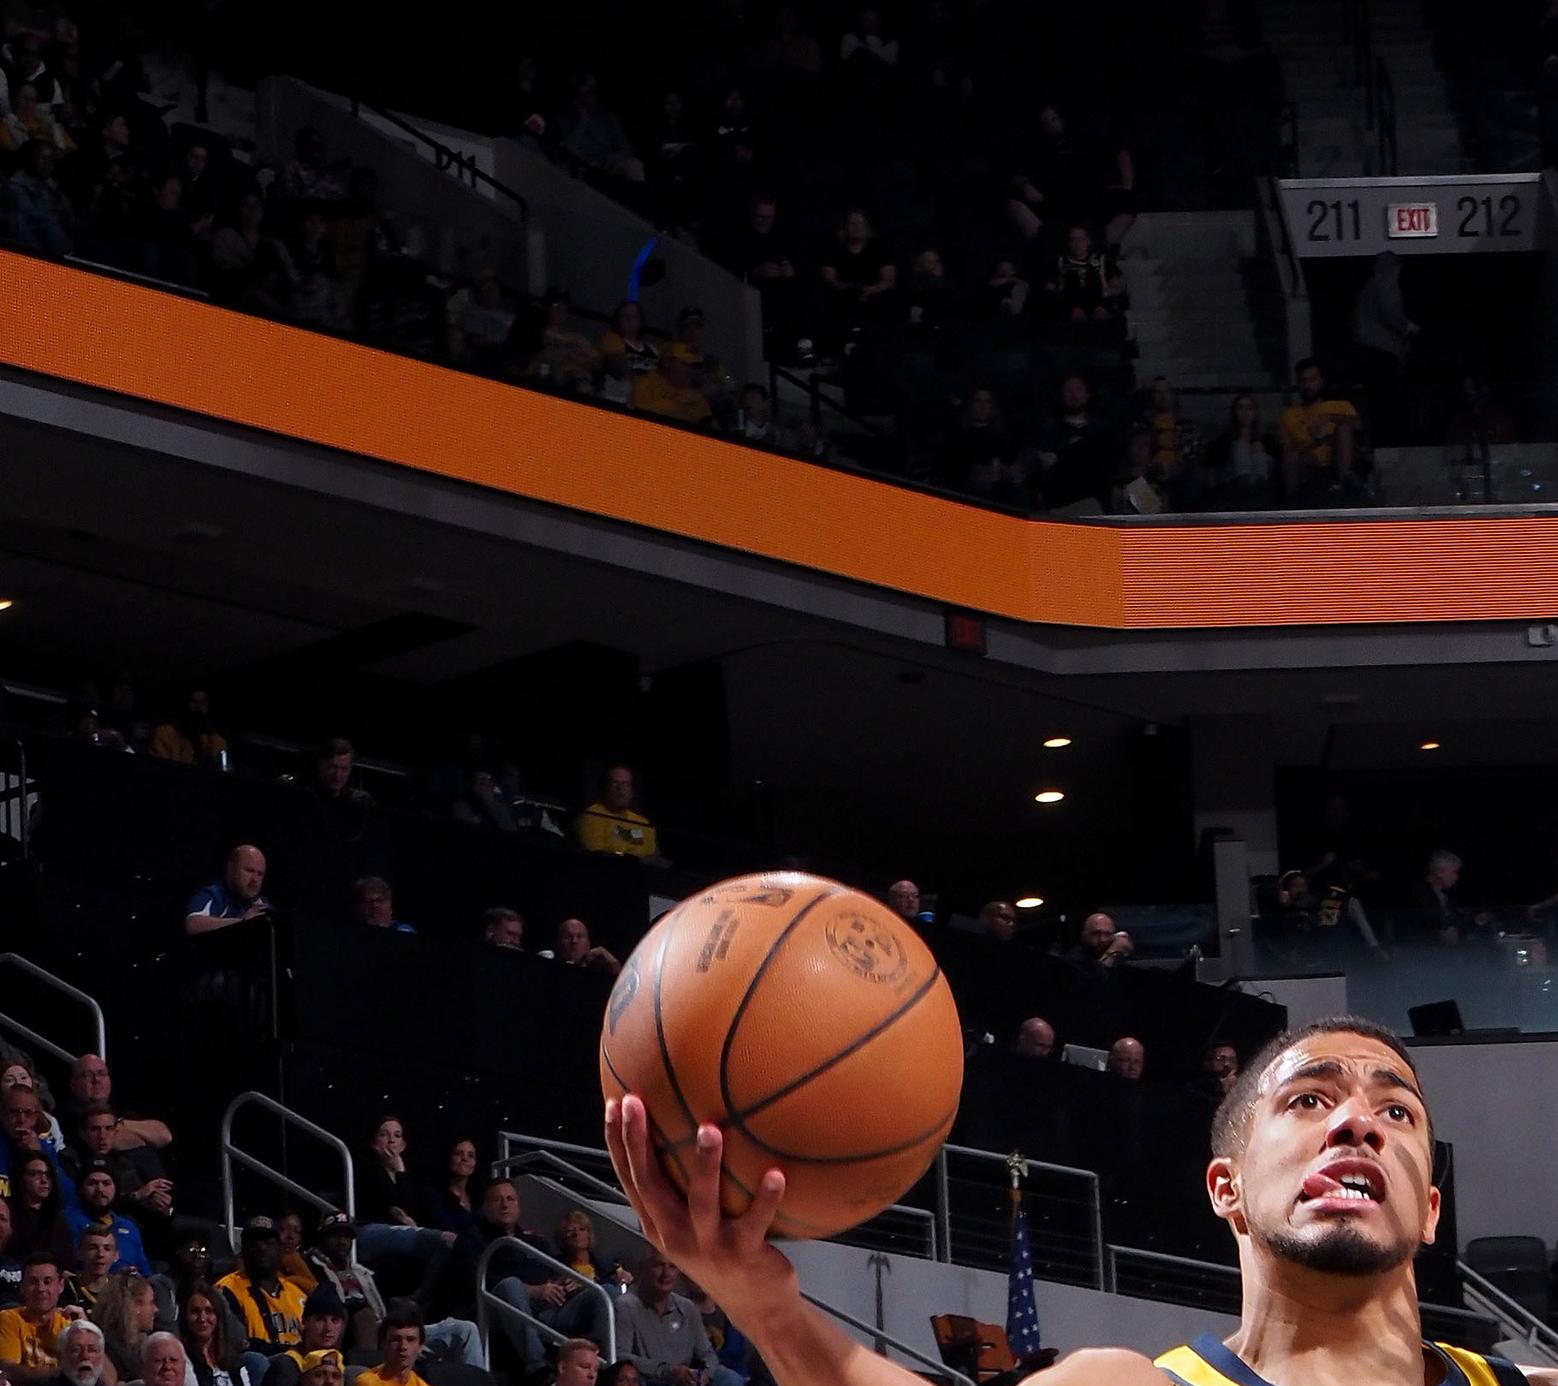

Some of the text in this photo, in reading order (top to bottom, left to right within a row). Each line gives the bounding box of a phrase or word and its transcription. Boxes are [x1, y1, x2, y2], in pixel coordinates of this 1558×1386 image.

[1307, 196, 1522, 242] 211 EXIT 212
